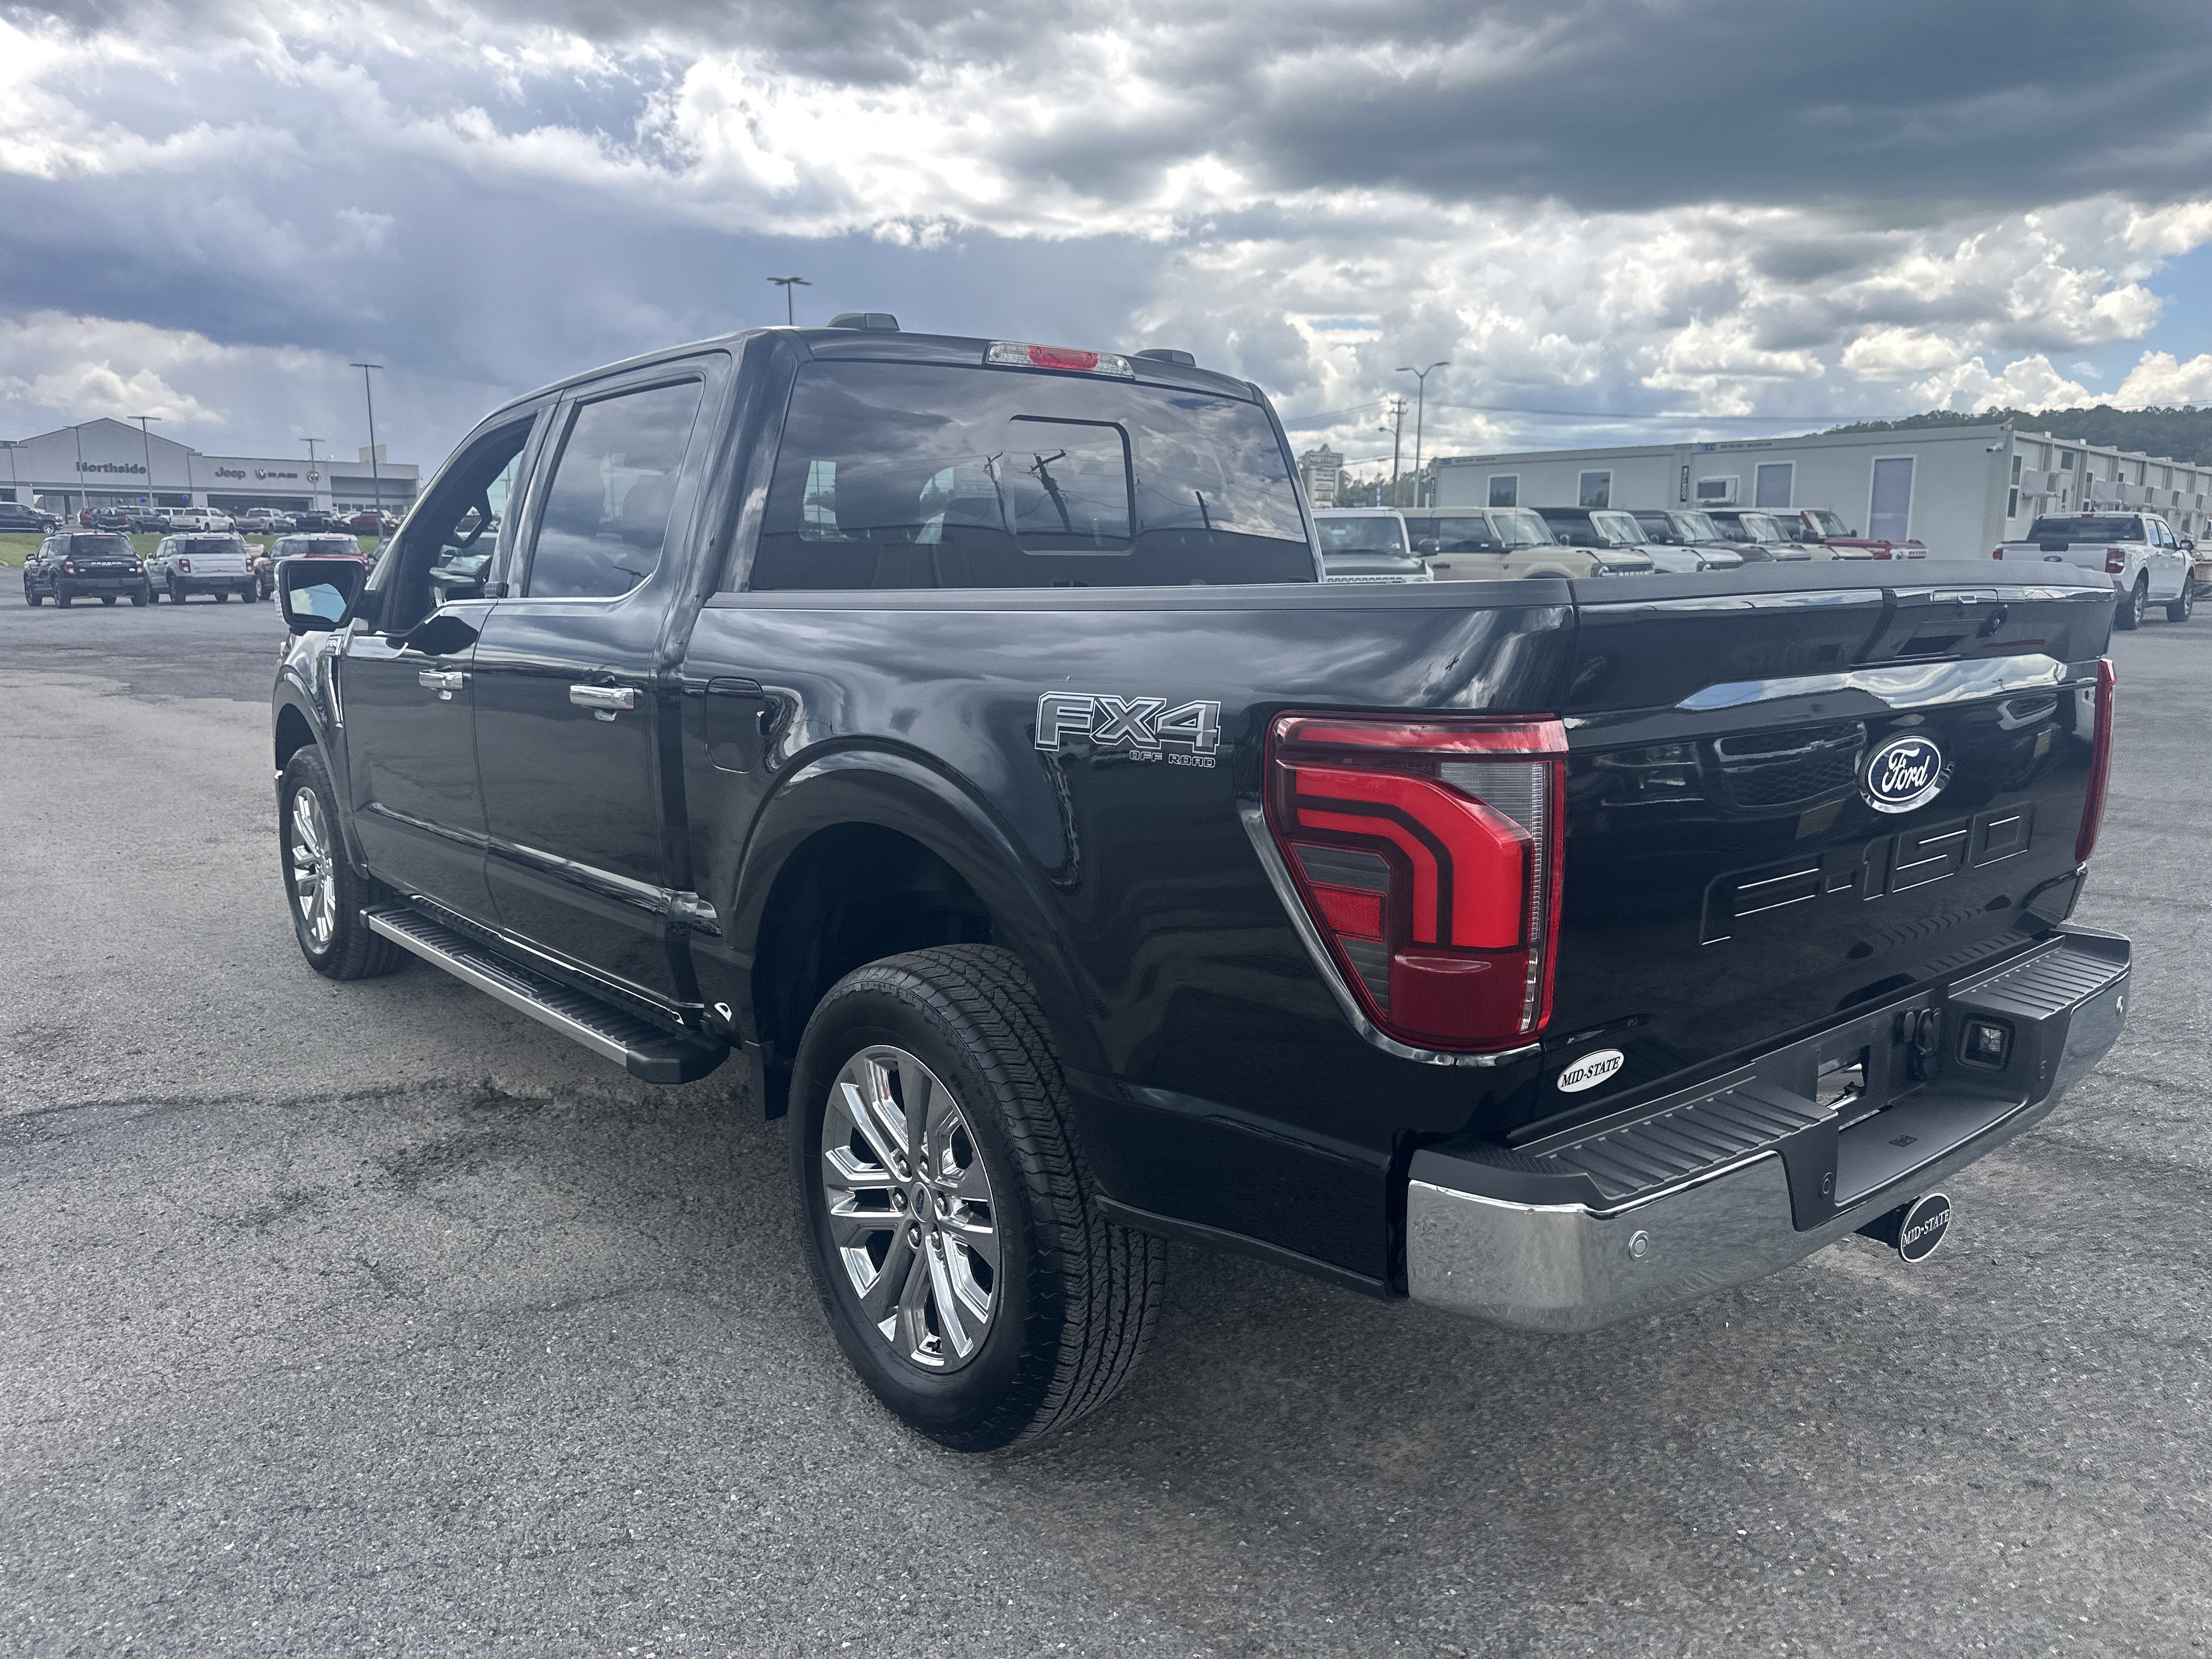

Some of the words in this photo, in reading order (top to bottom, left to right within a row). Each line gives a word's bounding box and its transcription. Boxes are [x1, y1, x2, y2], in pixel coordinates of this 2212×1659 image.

[76, 461, 146, 473] Northside
[215, 466, 246, 480] Jeep
[1034, 691, 1221, 755] FX4
[1129, 750, 1163, 762] OFF
[1168, 753, 1216, 769] ROAD
[1881, 747, 1931, 793] Ford
[1700, 800, 2036, 946] F-150
[1560, 1056, 1621, 1088] MID-STATE
[1902, 1209, 1950, 1248] MID-STATE
